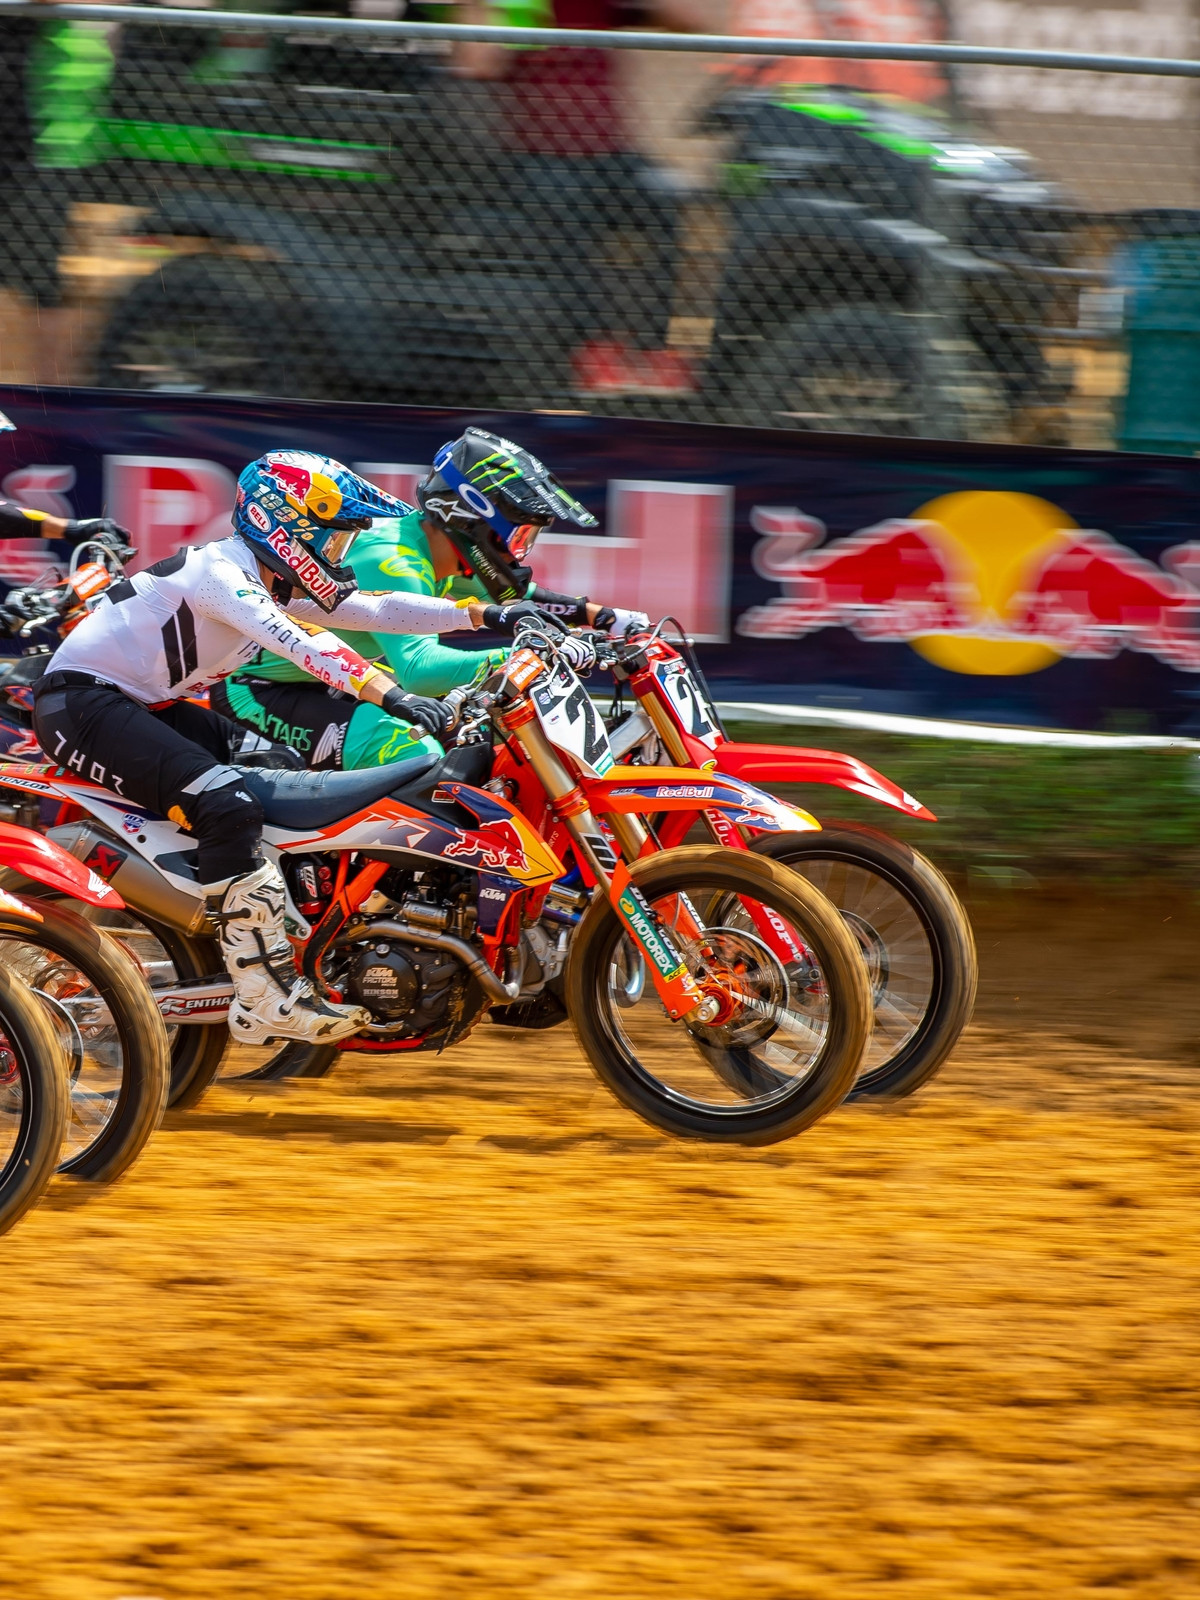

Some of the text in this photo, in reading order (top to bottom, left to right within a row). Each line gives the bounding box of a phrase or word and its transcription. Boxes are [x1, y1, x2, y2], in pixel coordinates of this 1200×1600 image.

[250, 505, 268, 530] BELL
[252, 483, 320, 542] 100%
[267, 526, 340, 600] Red Bull
[303, 654, 323, 678] Red
[565, 684, 609, 767] 2
[656, 785, 714, 799] Red Bull
[479, 887, 507, 901] KTM
[629, 911, 674, 974] MOTOREX
[365, 967, 394, 977] KTM
[158, 993, 234, 1016] RENTHA
